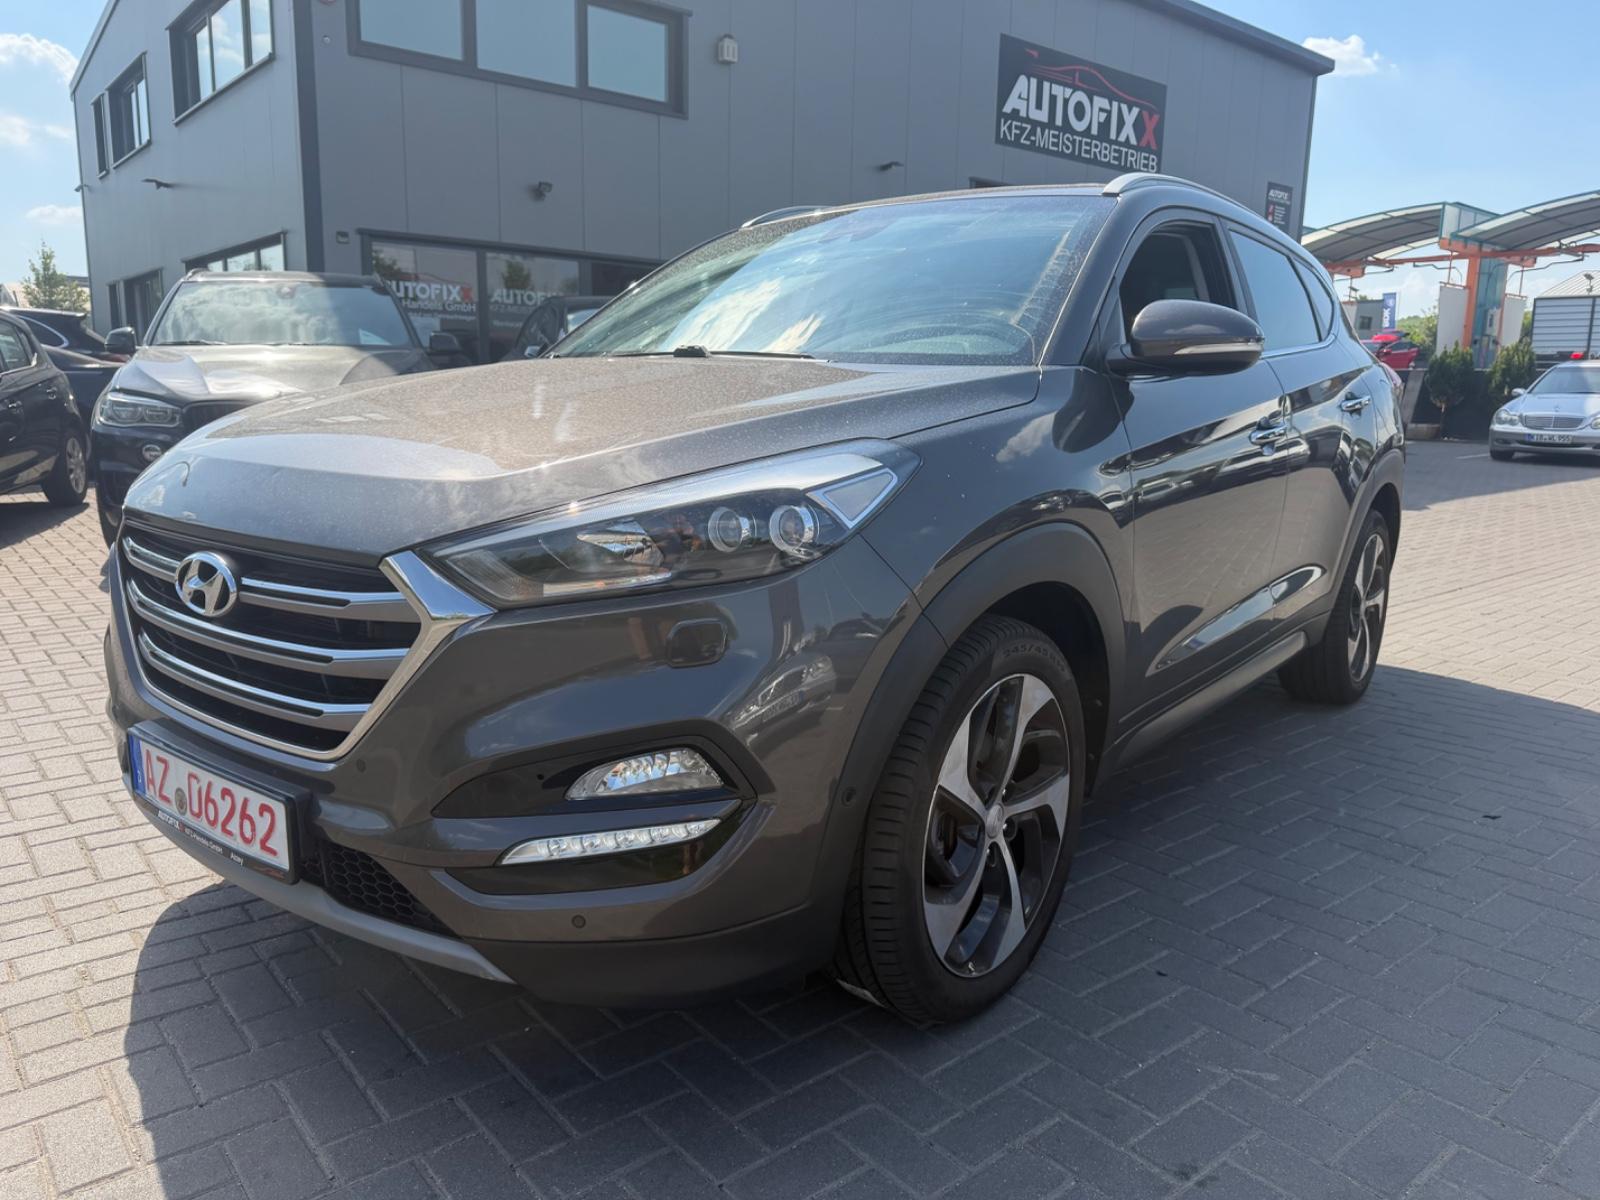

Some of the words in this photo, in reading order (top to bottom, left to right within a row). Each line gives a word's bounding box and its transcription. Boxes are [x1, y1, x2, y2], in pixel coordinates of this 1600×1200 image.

[1002, 74, 1160, 150] AUTOFIXX
[1000, 118, 1158, 173] KFZ-MEISTERBETRIEB
[445, 301, 477, 313] GmbH
[145, 748, 172, 806] AZ
[187, 771, 279, 857] 06262
